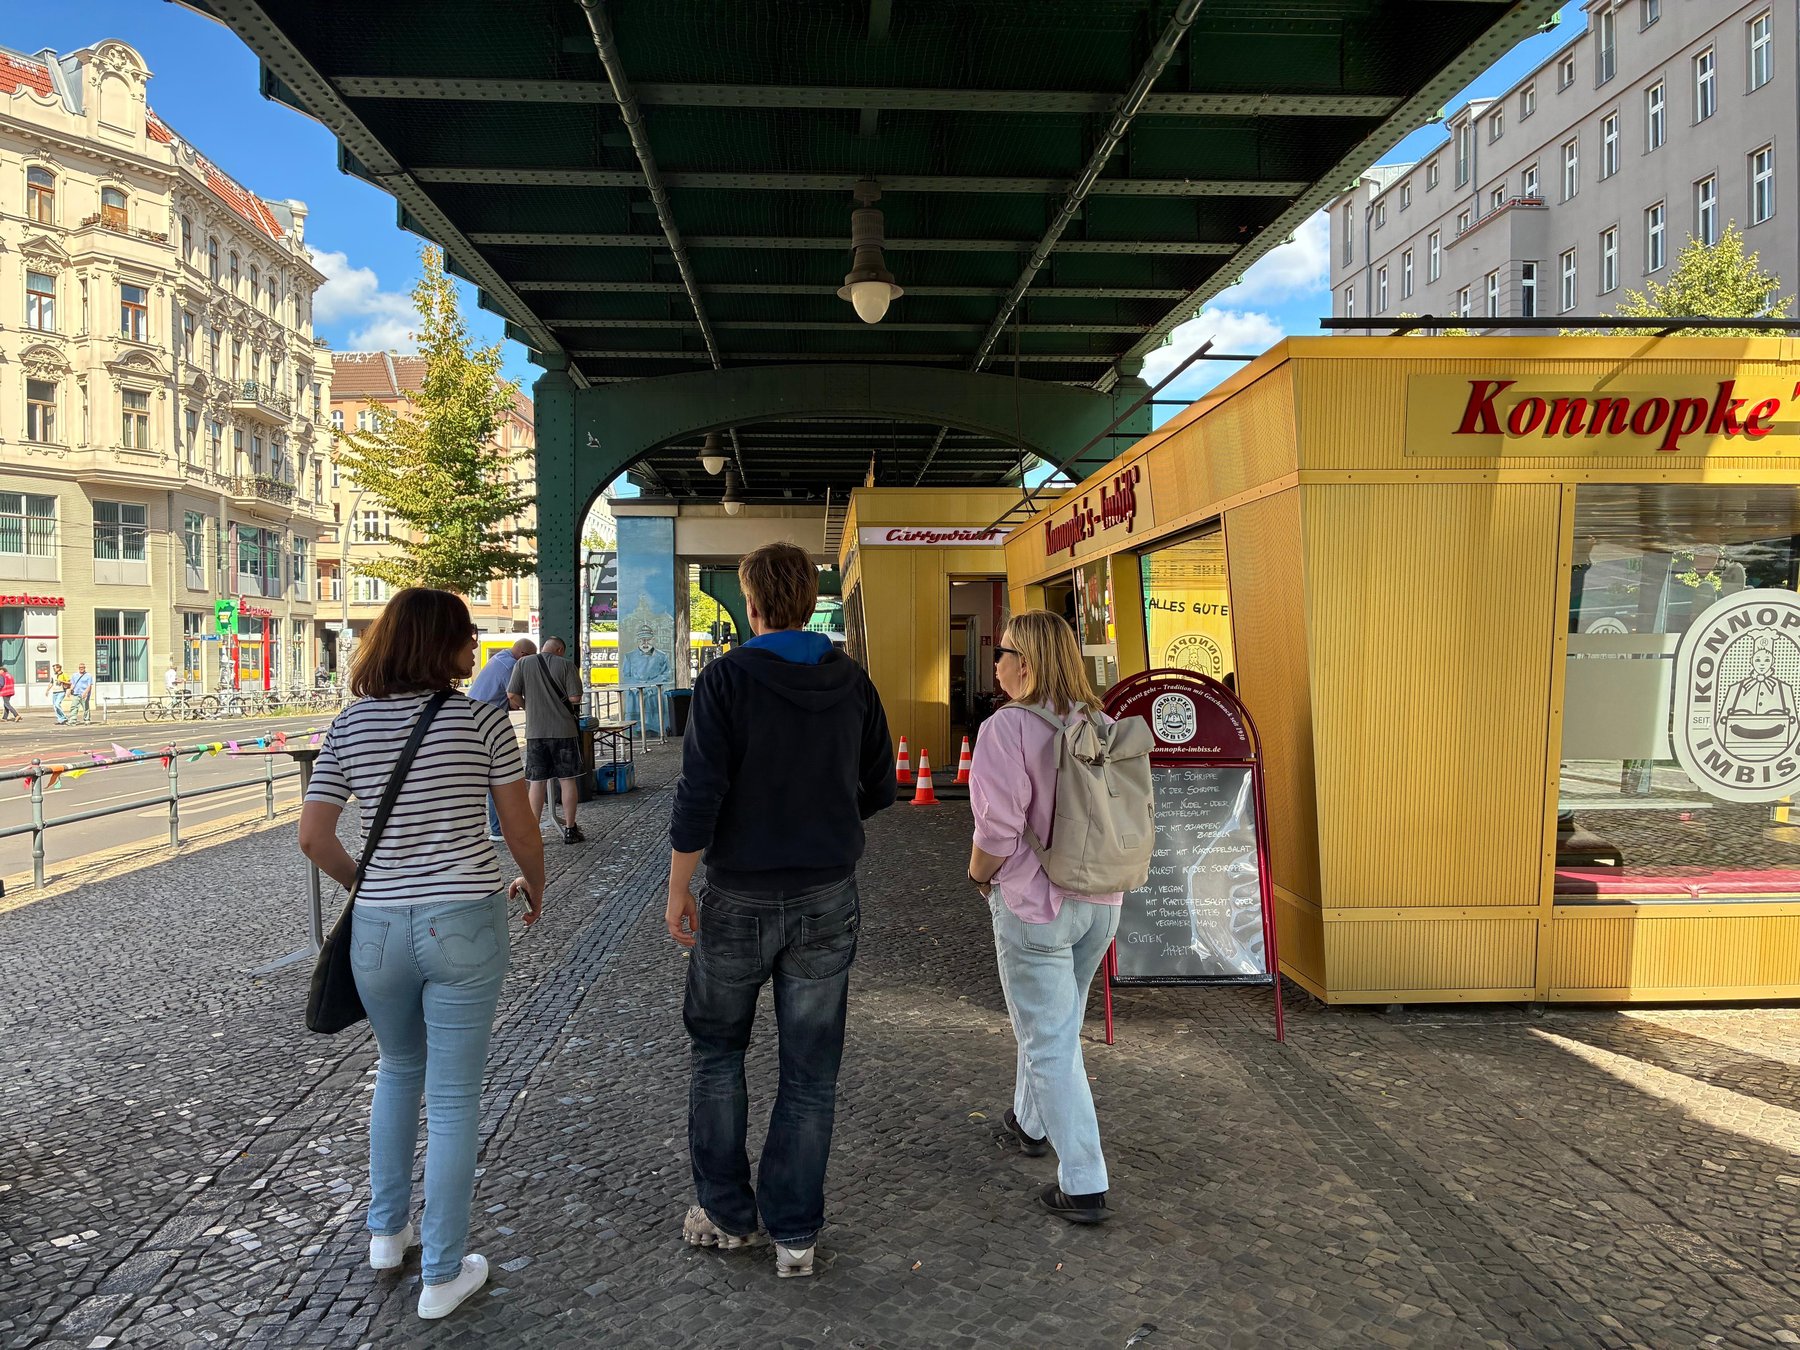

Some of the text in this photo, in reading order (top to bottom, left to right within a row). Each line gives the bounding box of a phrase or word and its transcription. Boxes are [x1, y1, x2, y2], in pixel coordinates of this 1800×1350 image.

[1149, 598, 1228, 616] ALLES GUTE
[1694, 607, 1800, 703] KONNOP
[1120, 703, 1129, 713] die
[1127, 692, 1144, 705] Wurst
[1144, 687, 1157, 697] geht
[1163, 684, 1192, 692] Tradition
[1193, 688, 1204, 696] mit
[1204, 693, 1233, 717] Geschmack
[1230, 716, 1240, 727] seit
[1693, 716, 1711, 724] SEIT
[1159, 727, 1191, 740] IMBISS
[1696, 737, 1800, 784] IMBIS
[1170, 773, 1181, 782] MIT
[1184, 771, 1218, 781] SCHRIPPE
[1162, 801, 1173, 809] MIT
[1171, 824, 1181, 832] MIT
[1176, 848, 1188, 856] MIT
[1192, 844, 1251, 855] KARTOFFELSALAT
[1158, 885, 1184, 893] VEGAN
[1145, 898, 1157, 906] MIT
[1159, 908, 1188, 918] POMMES
[1192, 909, 1220, 917] FRITES
[1127, 932, 1165, 944] GUTEN
